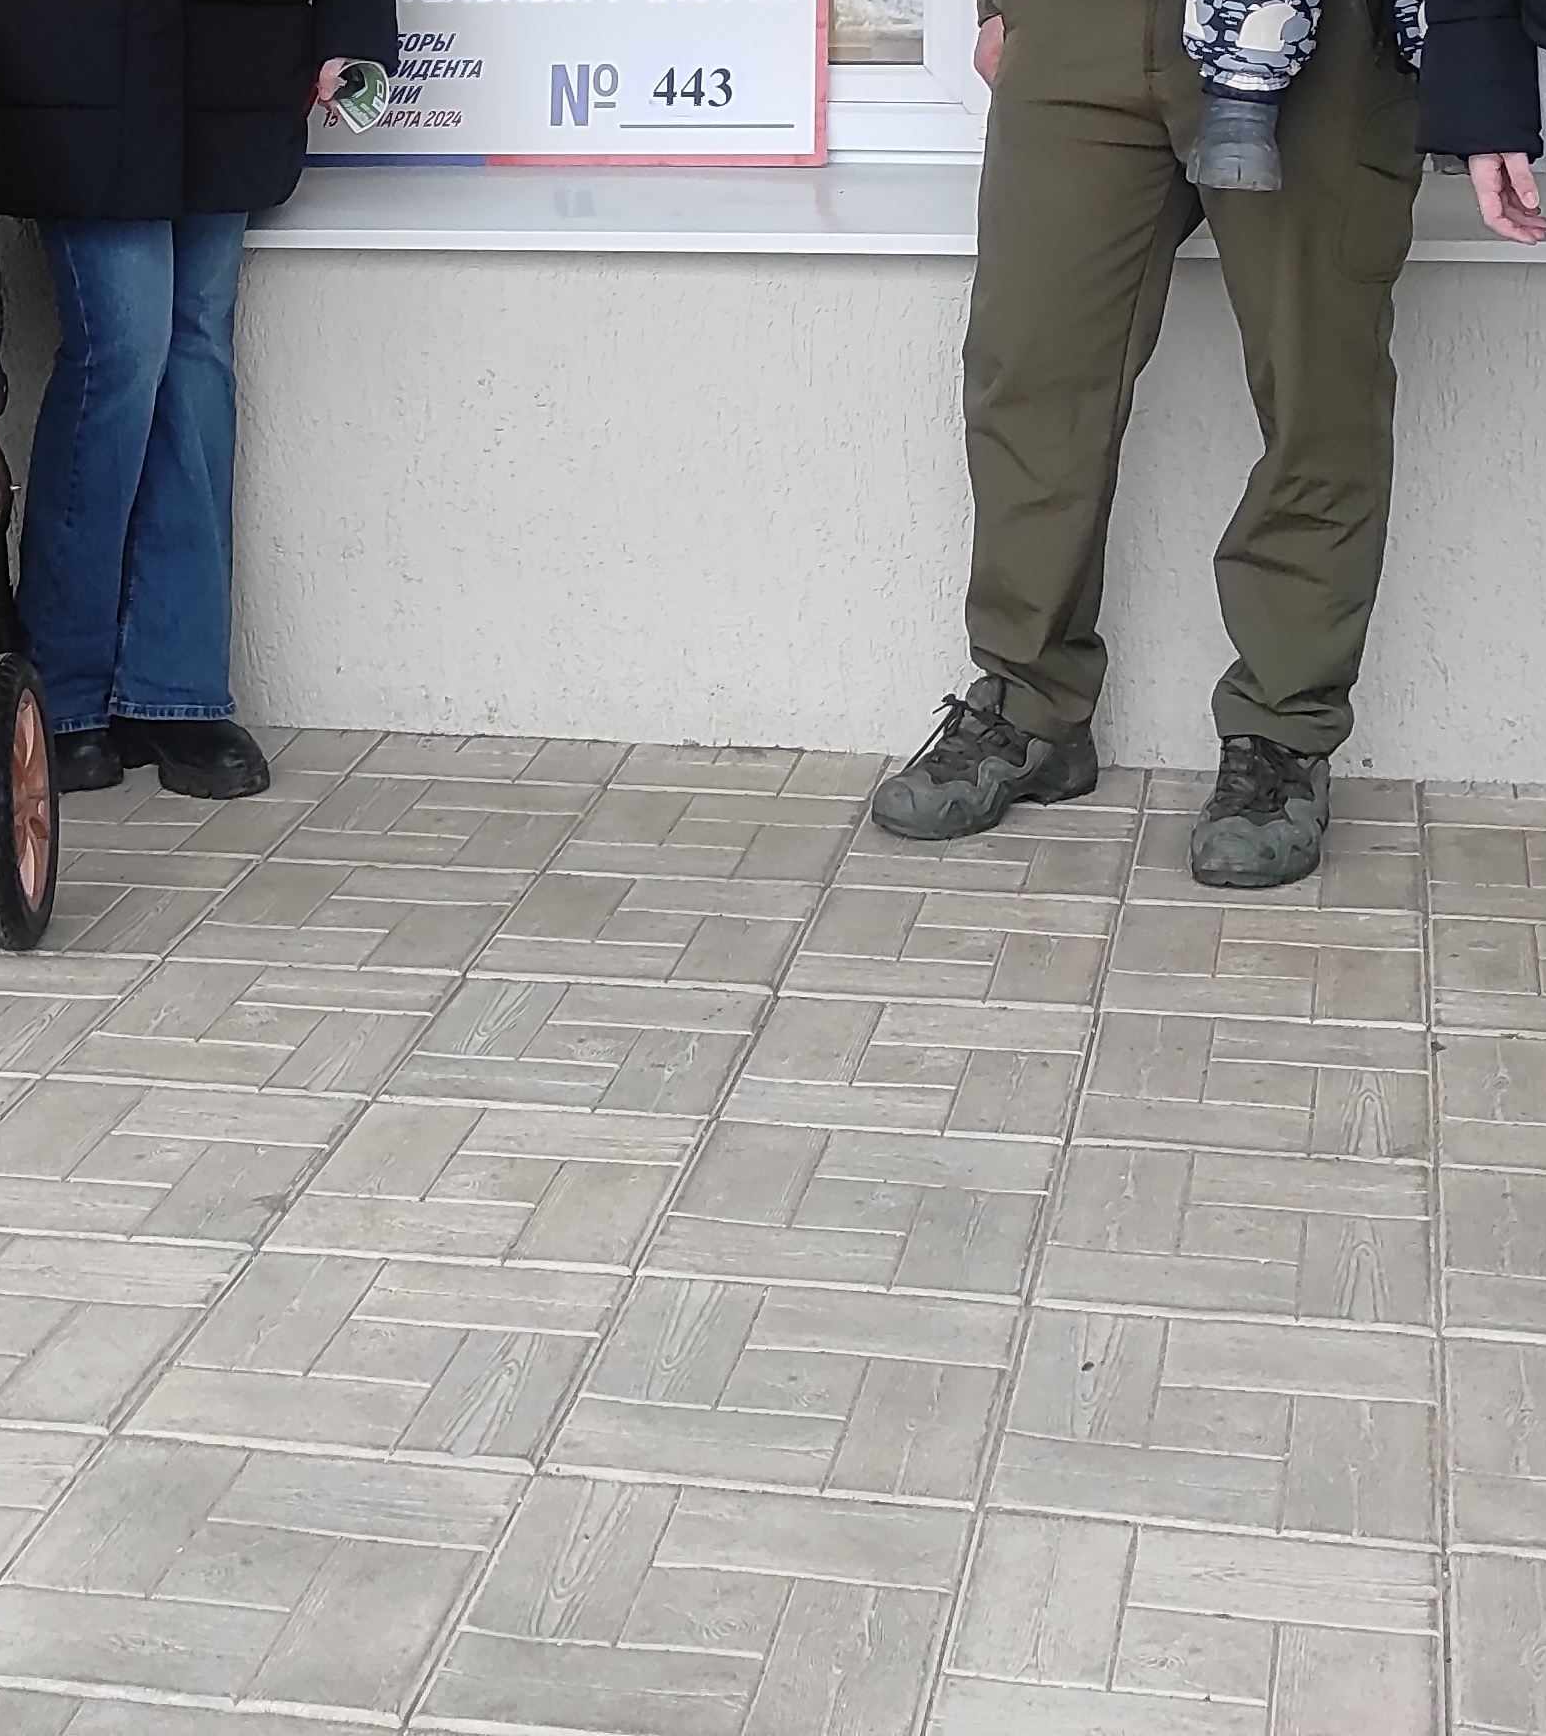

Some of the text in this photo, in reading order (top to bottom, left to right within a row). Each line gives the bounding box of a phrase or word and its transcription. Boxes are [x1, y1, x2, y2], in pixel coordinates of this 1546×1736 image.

[395, 59, 484, 82] ИДЕНТА
[388, 85, 423, 105] ИИ
[653, 66, 733, 108] 443
[374, 110, 422, 129] АРТА
[423, 110, 463, 129] 2024
